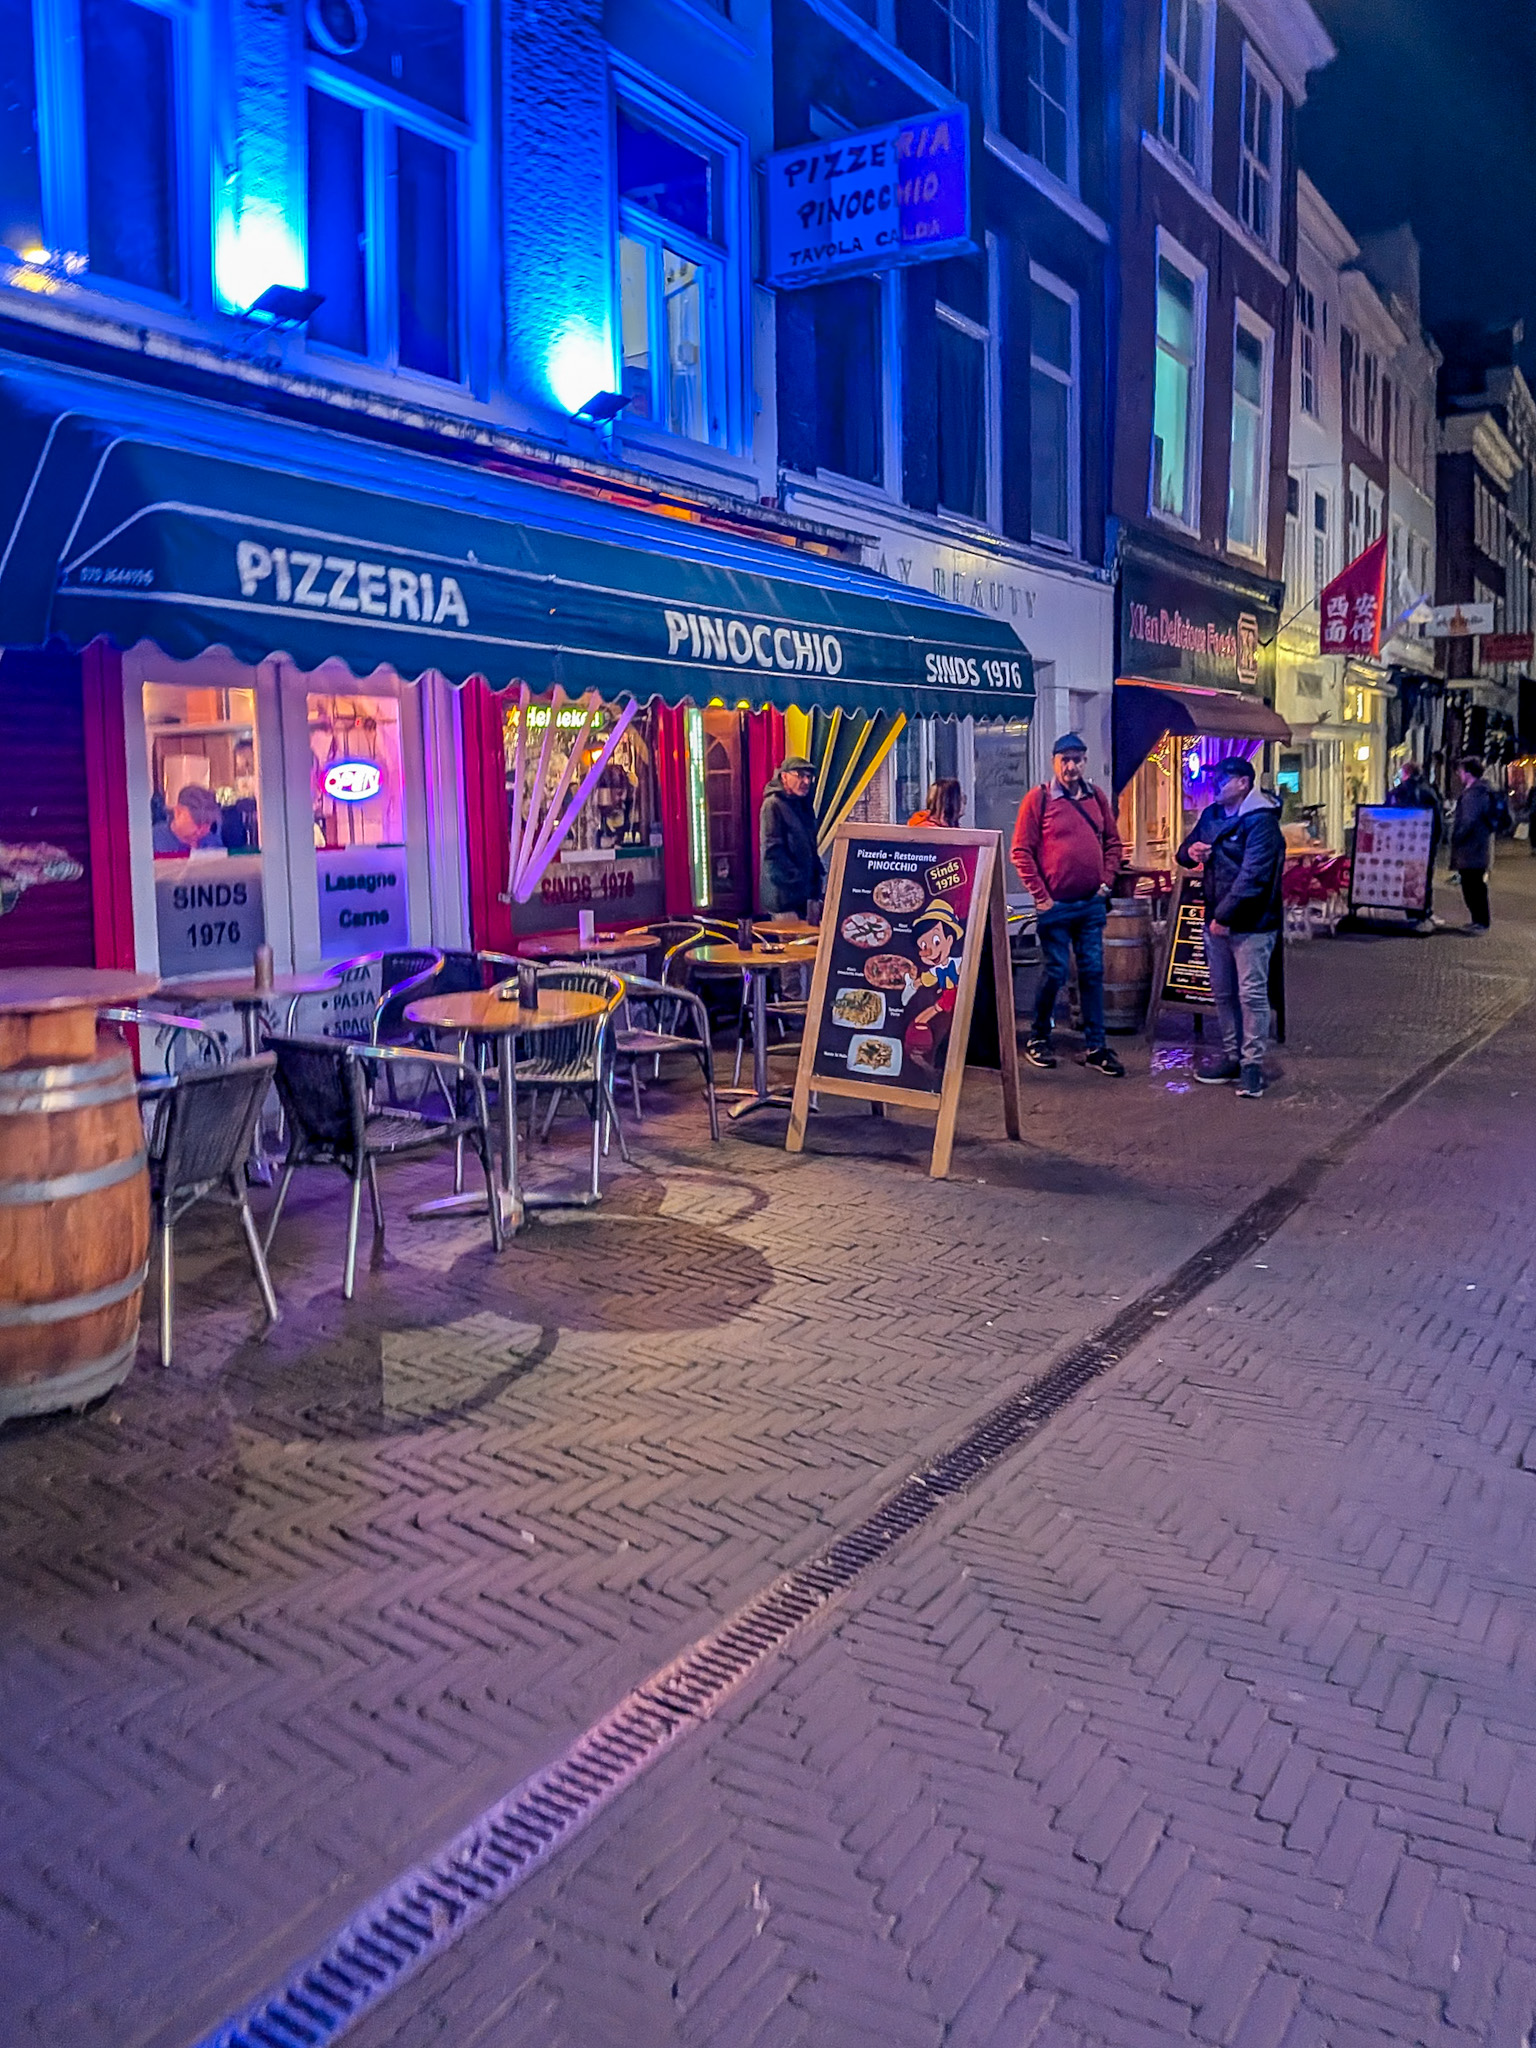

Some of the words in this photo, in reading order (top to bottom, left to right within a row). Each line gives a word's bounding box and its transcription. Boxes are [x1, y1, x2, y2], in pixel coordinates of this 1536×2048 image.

[784, 121, 950, 187] PIZZERIA
[797, 172, 939, 229] PINOCCHIO
[789, 238, 863, 266] TAVOLA
[876, 218, 941, 246] CALDA
[236, 539, 469, 628] PIZZERIA
[933, 567, 1037, 618] BEAUTY
[1326, 593, 1378, 619] 西安
[1160, 609, 1207, 654] Delicious
[1207, 622, 1237, 657] Foods
[664, 610, 843, 675] PINOCCHIO
[925, 652, 980, 687] SINDS
[982, 659, 1022, 690] 1976
[856, 849, 887, 860] Pizzeria
[894, 851, 937, 862] Restorante
[867, 860, 918, 872] PINOCCHIO
[930, 861, 960, 880] Sinds
[936, 874, 960, 890] 1976
[173, 882, 248, 910] SINDS
[542, 875, 593, 904] SINDS
[600, 871, 635, 900] 1976
[339, 909, 390, 928] Carne
[187, 922, 241, 948] 1976
[333, 990, 376, 1010] PASTA
